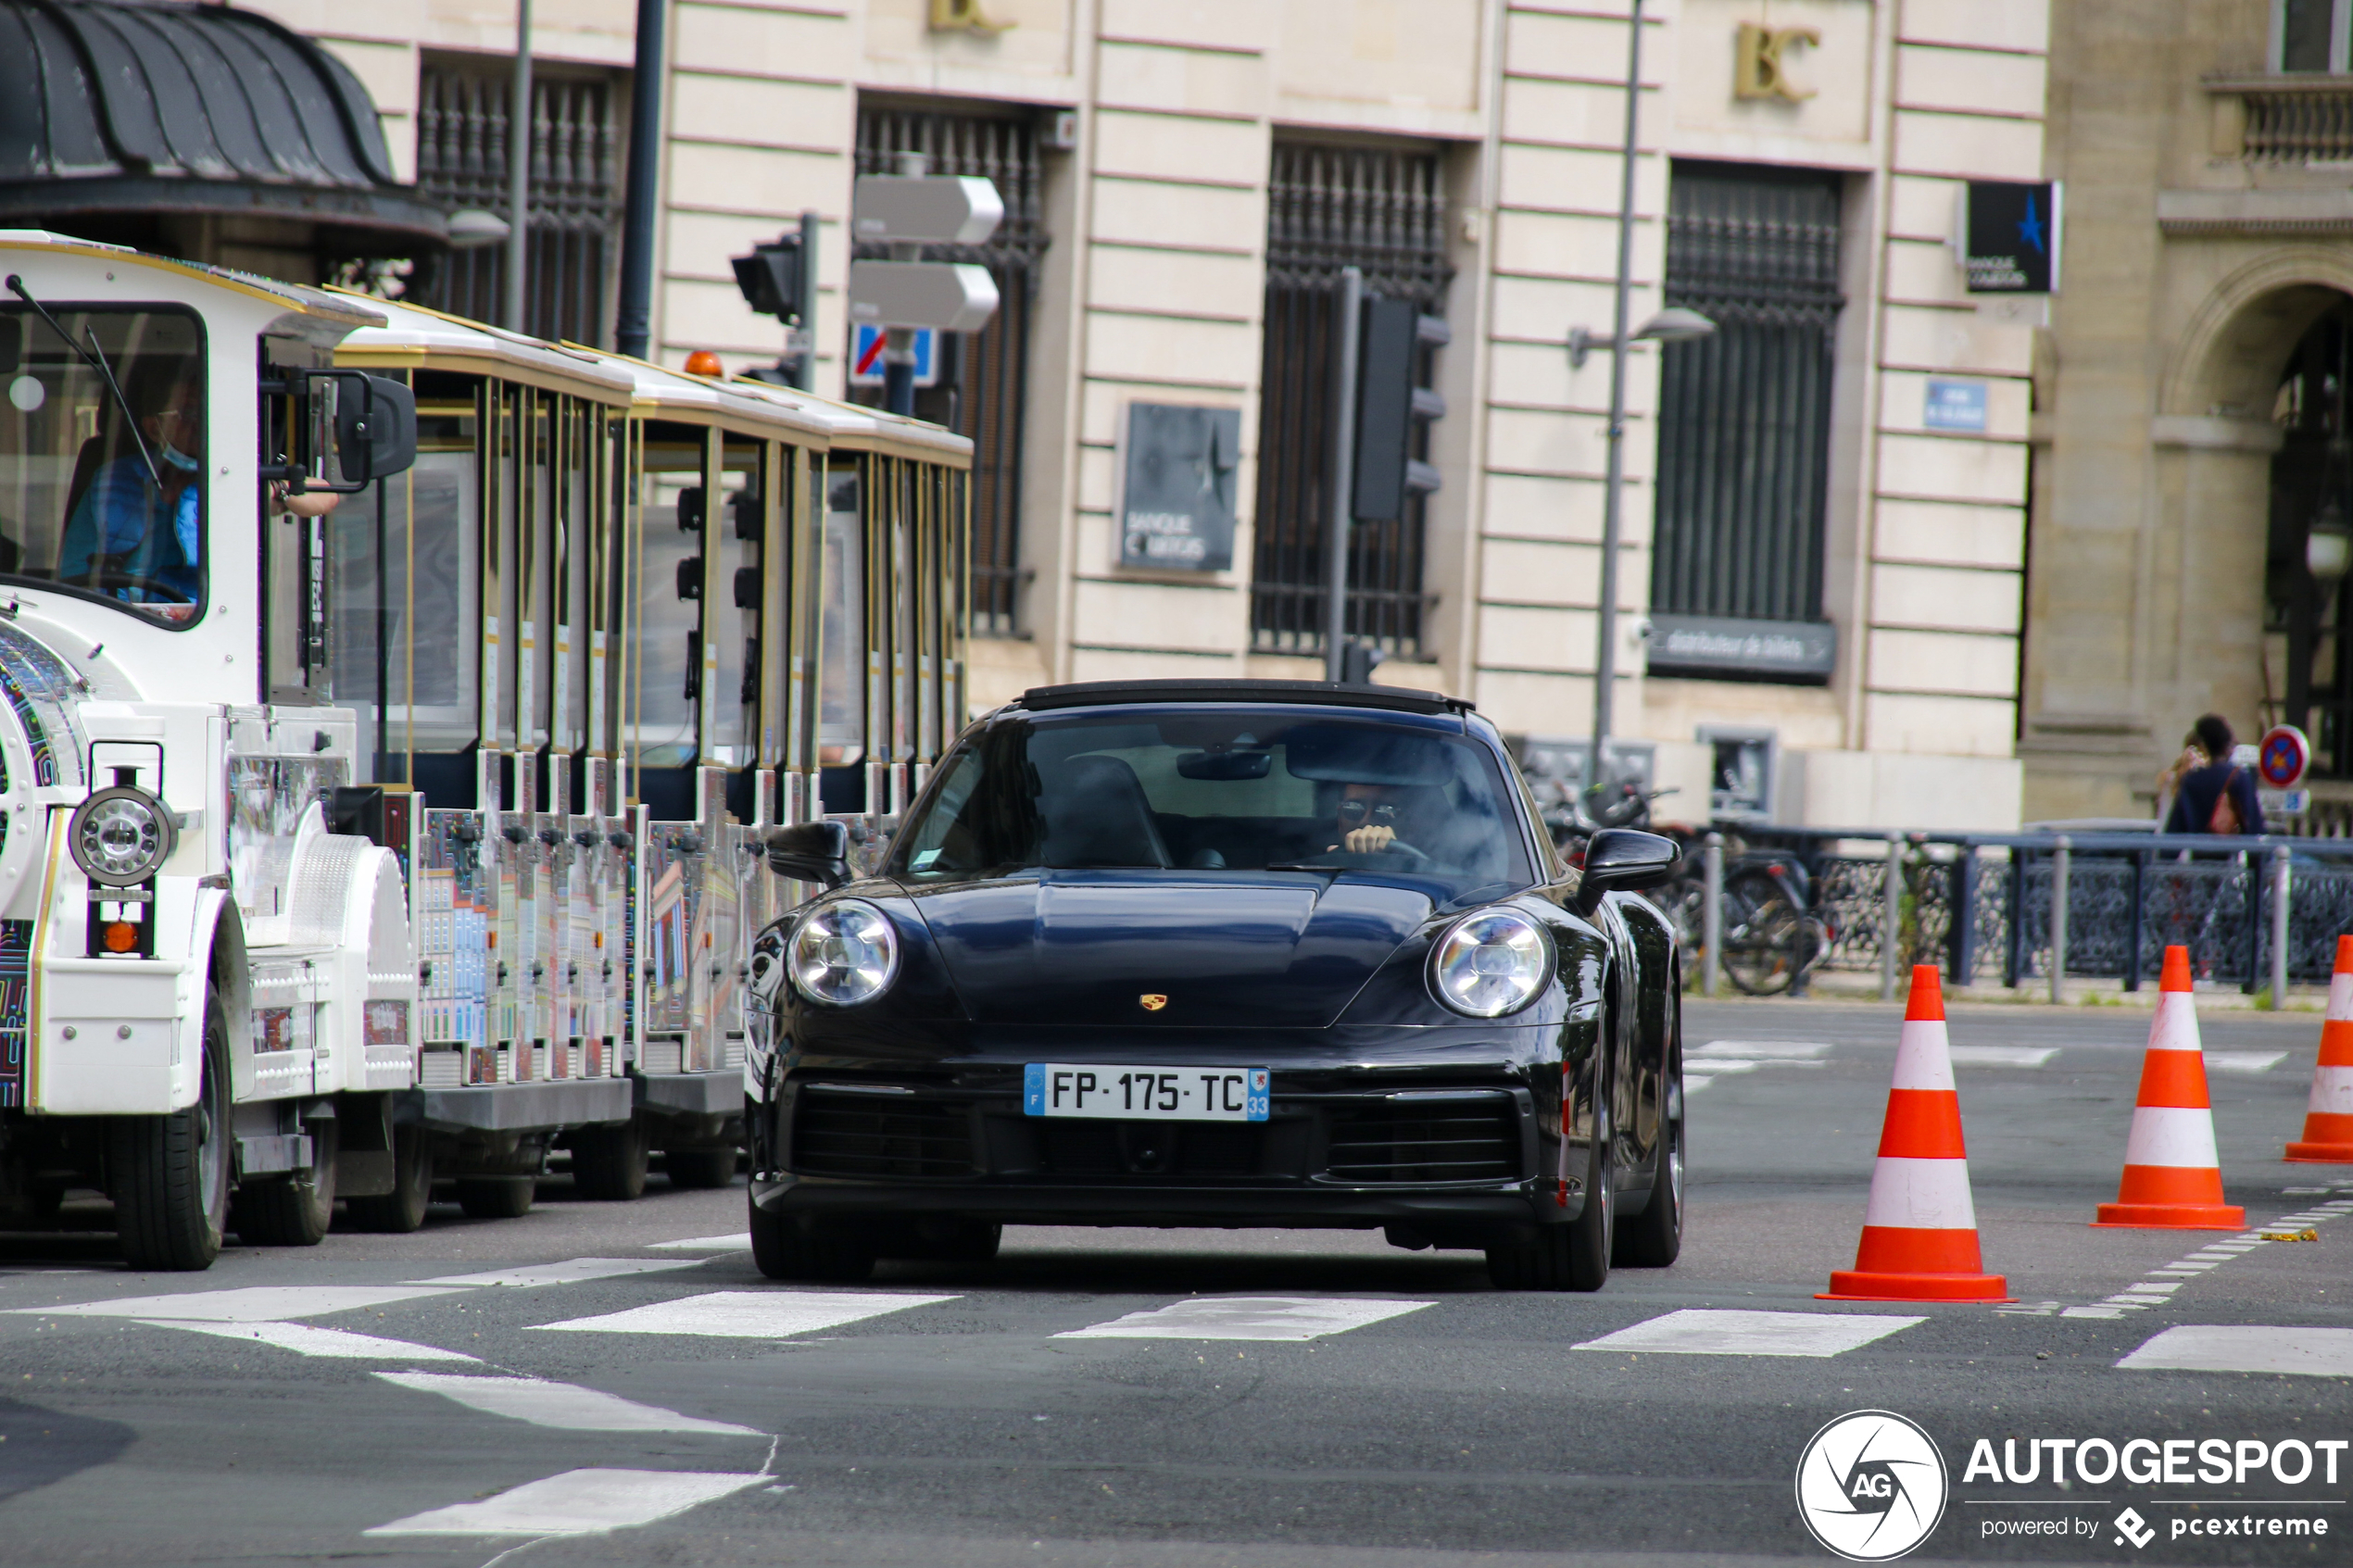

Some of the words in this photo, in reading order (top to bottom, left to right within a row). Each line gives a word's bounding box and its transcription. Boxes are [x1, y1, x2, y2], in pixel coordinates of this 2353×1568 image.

[1736, 21, 1821, 102] BC
[1968, 256, 2017, 271] BANQUE
[1127, 511, 1192, 534] BANQUE
[1125, 533, 1205, 560] CURTOIS
[1668, 630, 1743, 659] distributeur
[1744, 634, 1761, 659] de
[1763, 634, 1804, 662] billets
[1030, 1094, 1038, 1106] F
[1248, 1096, 1269, 1115] 33
